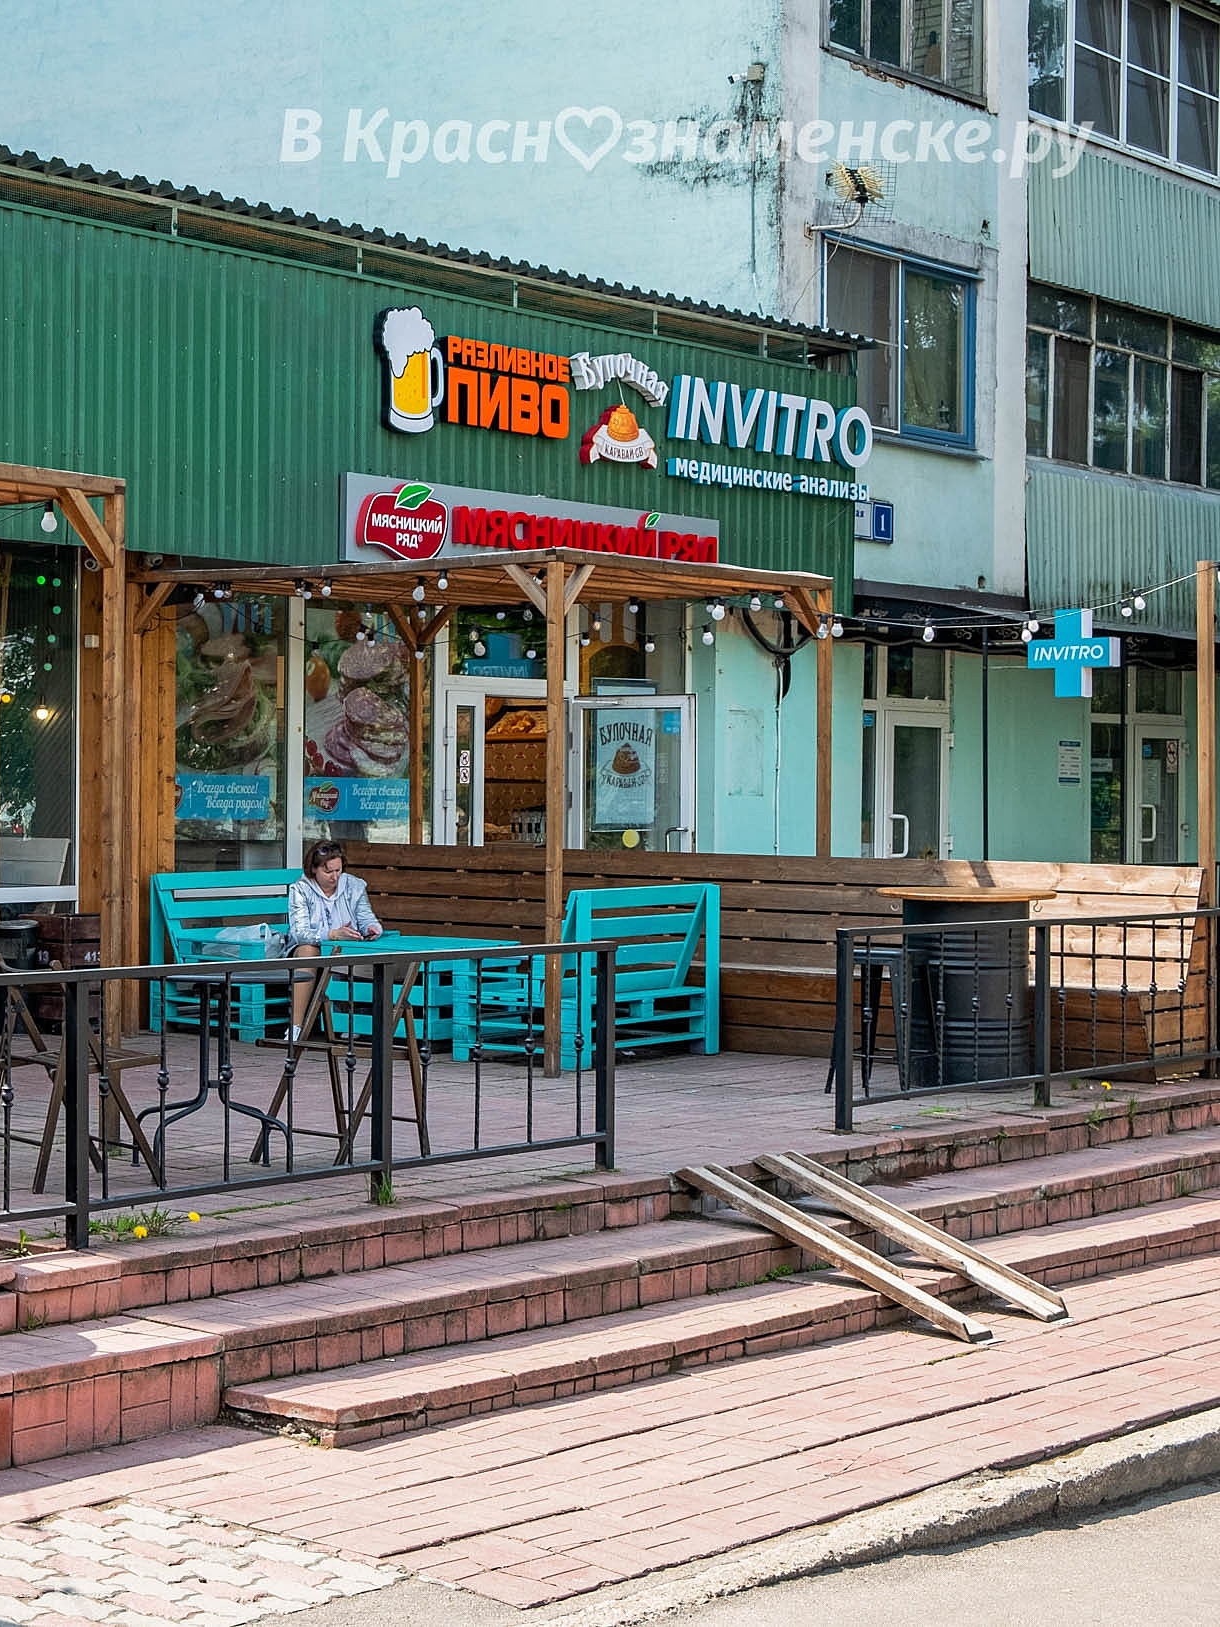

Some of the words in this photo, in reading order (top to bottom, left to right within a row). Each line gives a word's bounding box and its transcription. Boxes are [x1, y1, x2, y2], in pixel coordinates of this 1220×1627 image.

[447, 335, 570, 383] РАЗЛИВНОЕ
[447, 366, 570, 439] ПИВО
[672, 374, 873, 469] INVITRO
[674, 457, 793, 492] медицинские
[799, 474, 870, 502] анализы
[371, 512, 443, 534] МЯСНИЦКИЙ
[454, 505, 657, 557] МЯСНИЦКИЙ
[880, 514, 886, 531] 1
[1033, 644, 1104, 662] INVITRO
[599, 722, 653, 746] БУЛОЧНАЯ
[196, 781, 225, 798] Всегда
[206, 796, 234, 814] Всегда
